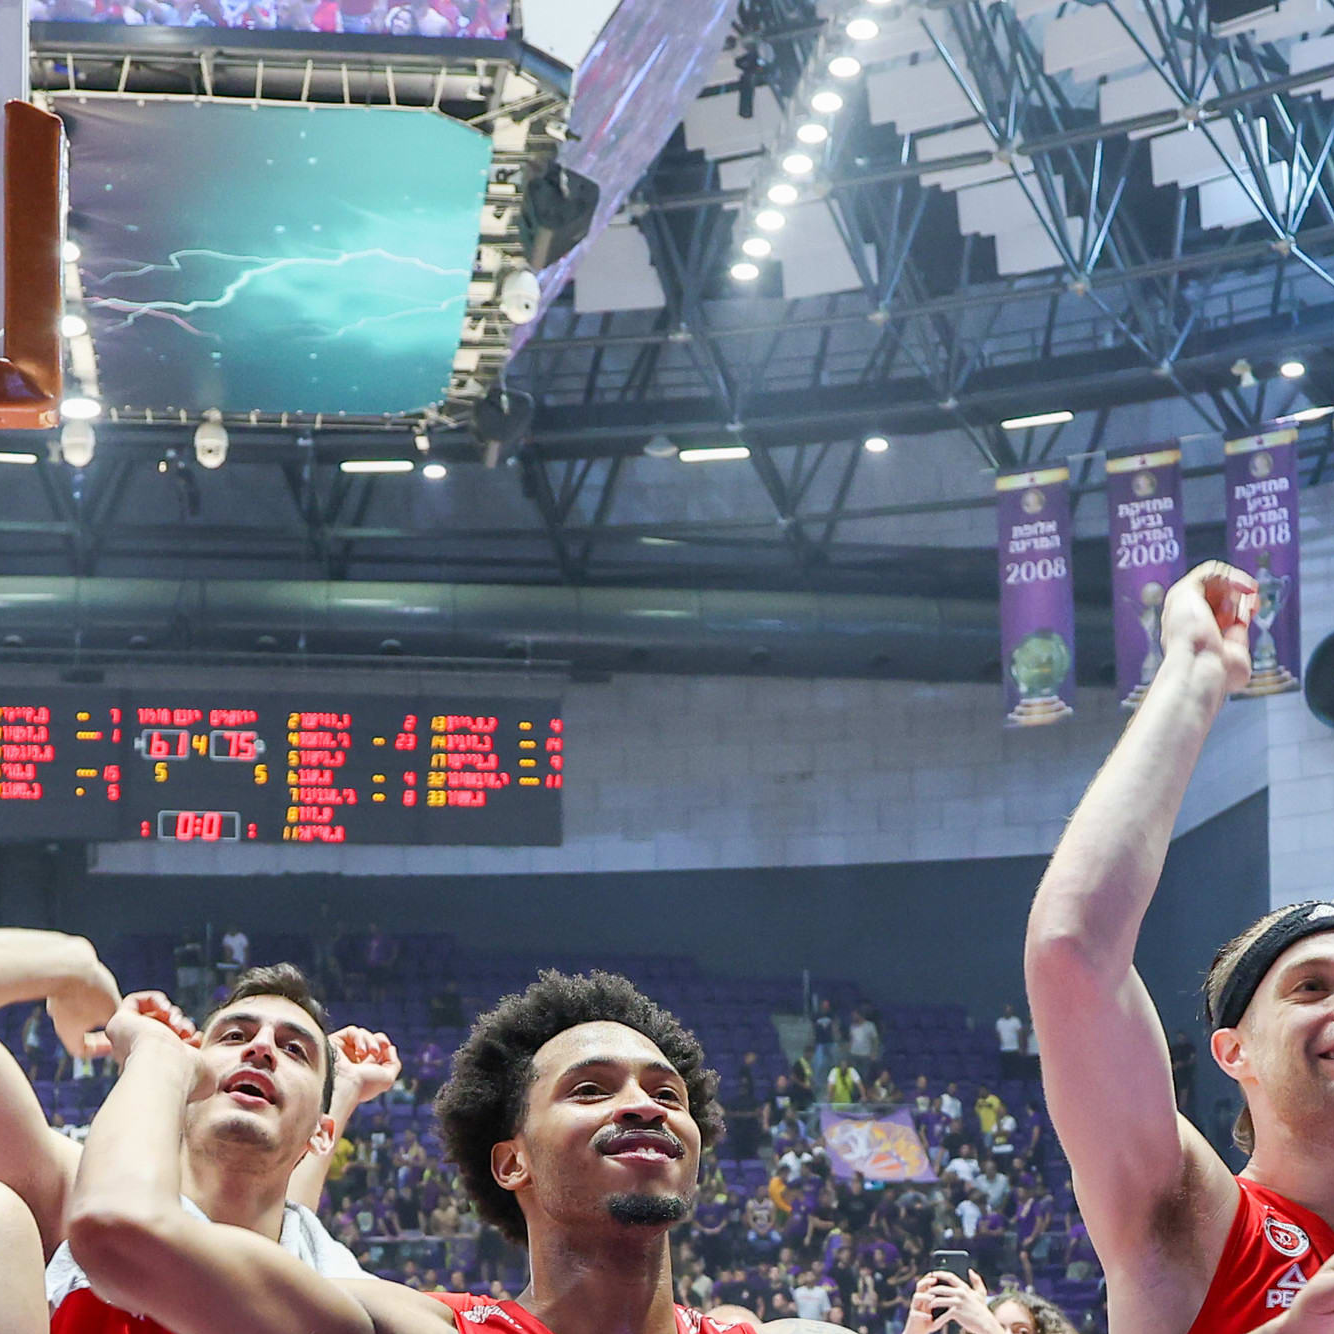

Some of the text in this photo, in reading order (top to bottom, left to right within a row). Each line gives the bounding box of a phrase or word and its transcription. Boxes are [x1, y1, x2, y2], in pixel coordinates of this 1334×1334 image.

[1235, 521, 1291, 551] 2018
[1118, 539, 1180, 569] 2009
[1005, 557, 1066, 584] 2008
[150, 732, 188, 758] 61
[192, 735, 209, 756] 4
[223, 731, 257, 761] 75
[154, 762, 168, 782] 5
[254, 764, 268, 785] 5
[1266, 1288, 1295, 1308] PE
